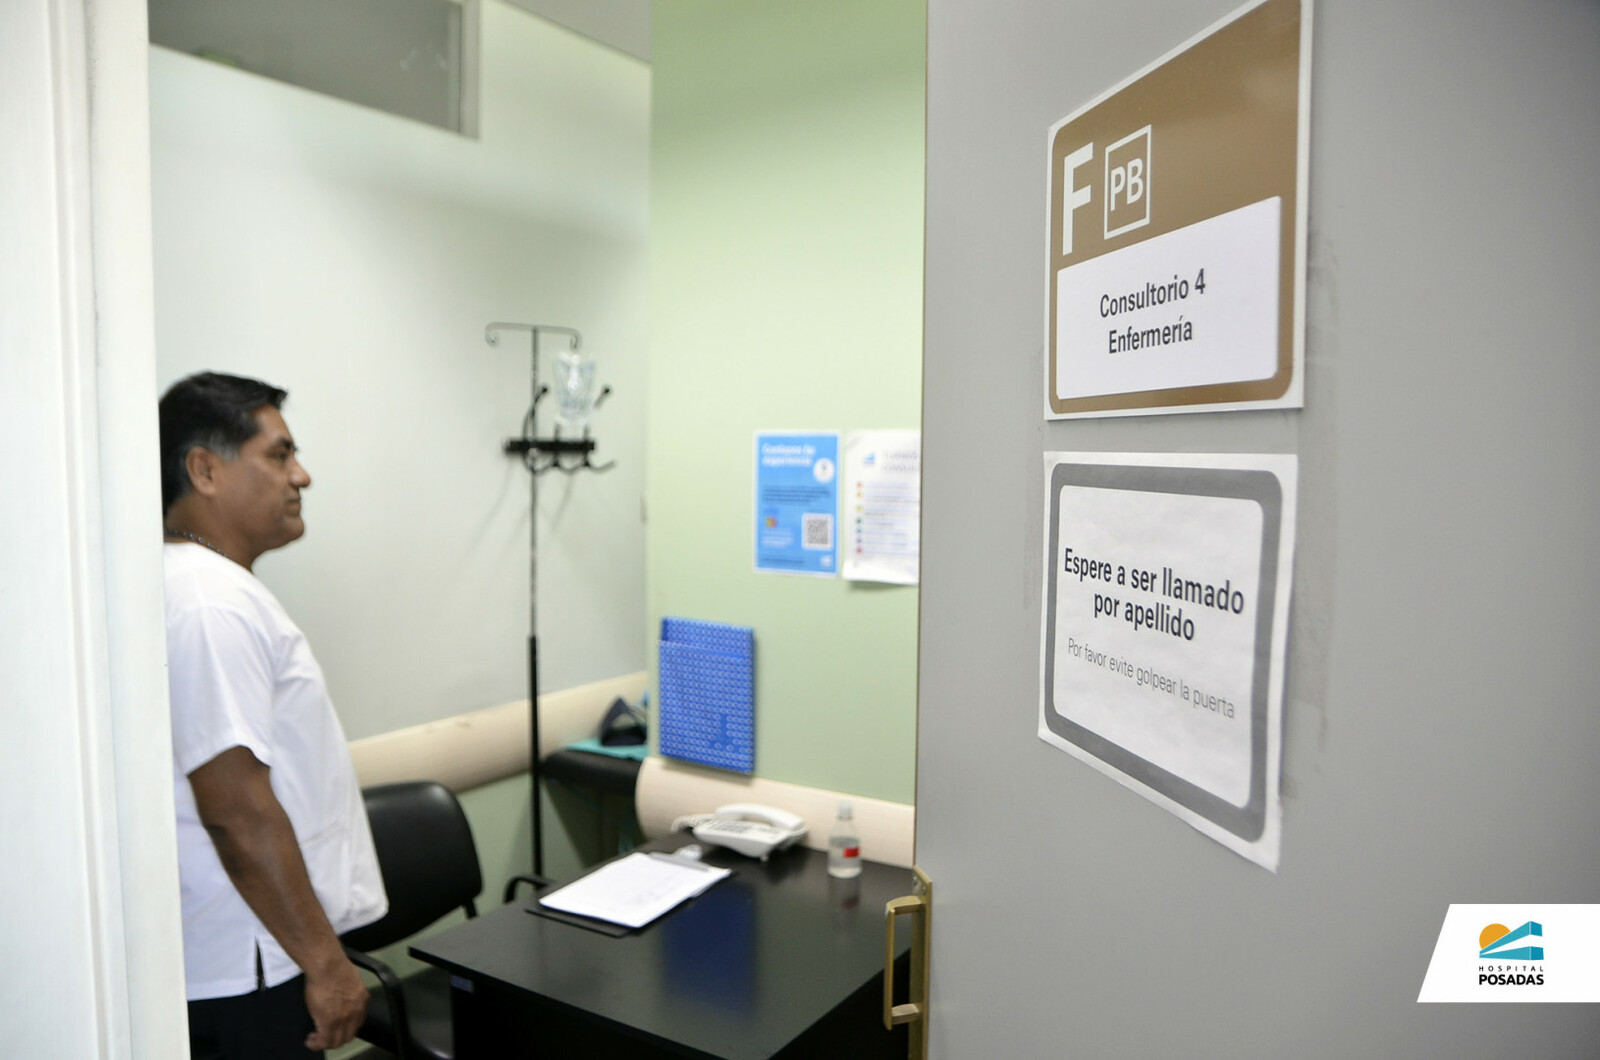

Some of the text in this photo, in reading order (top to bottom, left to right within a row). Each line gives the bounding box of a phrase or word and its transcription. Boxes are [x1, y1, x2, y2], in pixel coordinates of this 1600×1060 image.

[1062, 141, 1094, 256] F
[1110, 157, 1144, 212] PB
[1099, 268, 1207, 318] Consultorio 4
[1108, 315, 1193, 354] Enfermería
[1064, 547, 1245, 614] Espere a ser llamado
[1093, 592, 1196, 641] por apellido
[1068, 637, 1235, 719] Por favor evite golpear la puerta
